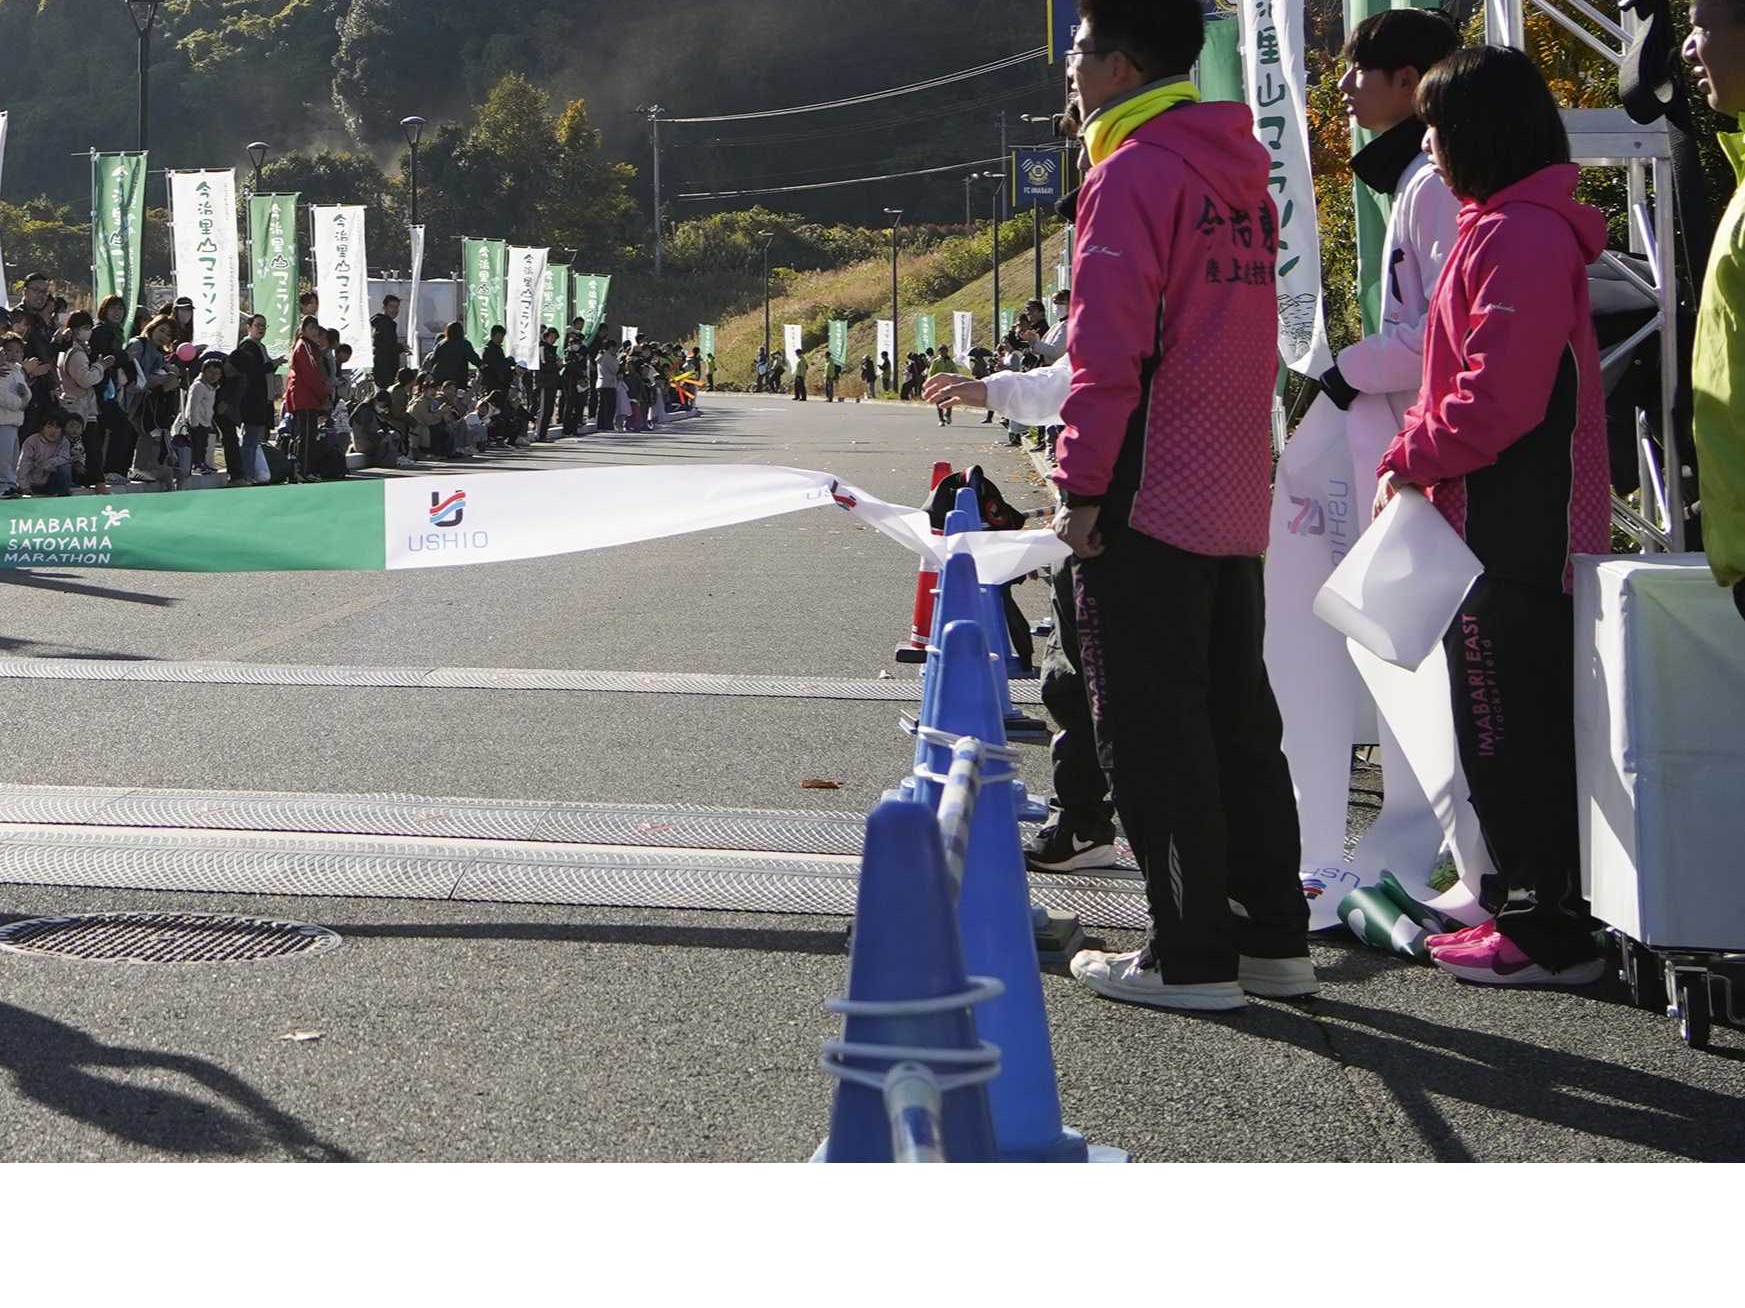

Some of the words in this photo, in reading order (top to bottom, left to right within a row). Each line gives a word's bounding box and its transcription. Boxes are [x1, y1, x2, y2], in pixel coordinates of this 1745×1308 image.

[196, 180, 218, 325] 今治里山マラソン
[271, 203, 290, 333] 今治里山マラソン
[334, 213, 351, 331] 今治里山マラソン
[7, 535, 113, 551] SATOYAMA
[9, 516, 98, 534] IMABARI
[407, 530, 489, 553] USHIO
[3, 552, 112, 564] MARATHON
[1462, 613, 1483, 662] EAST
[1467, 668, 1495, 757] IMABARI
